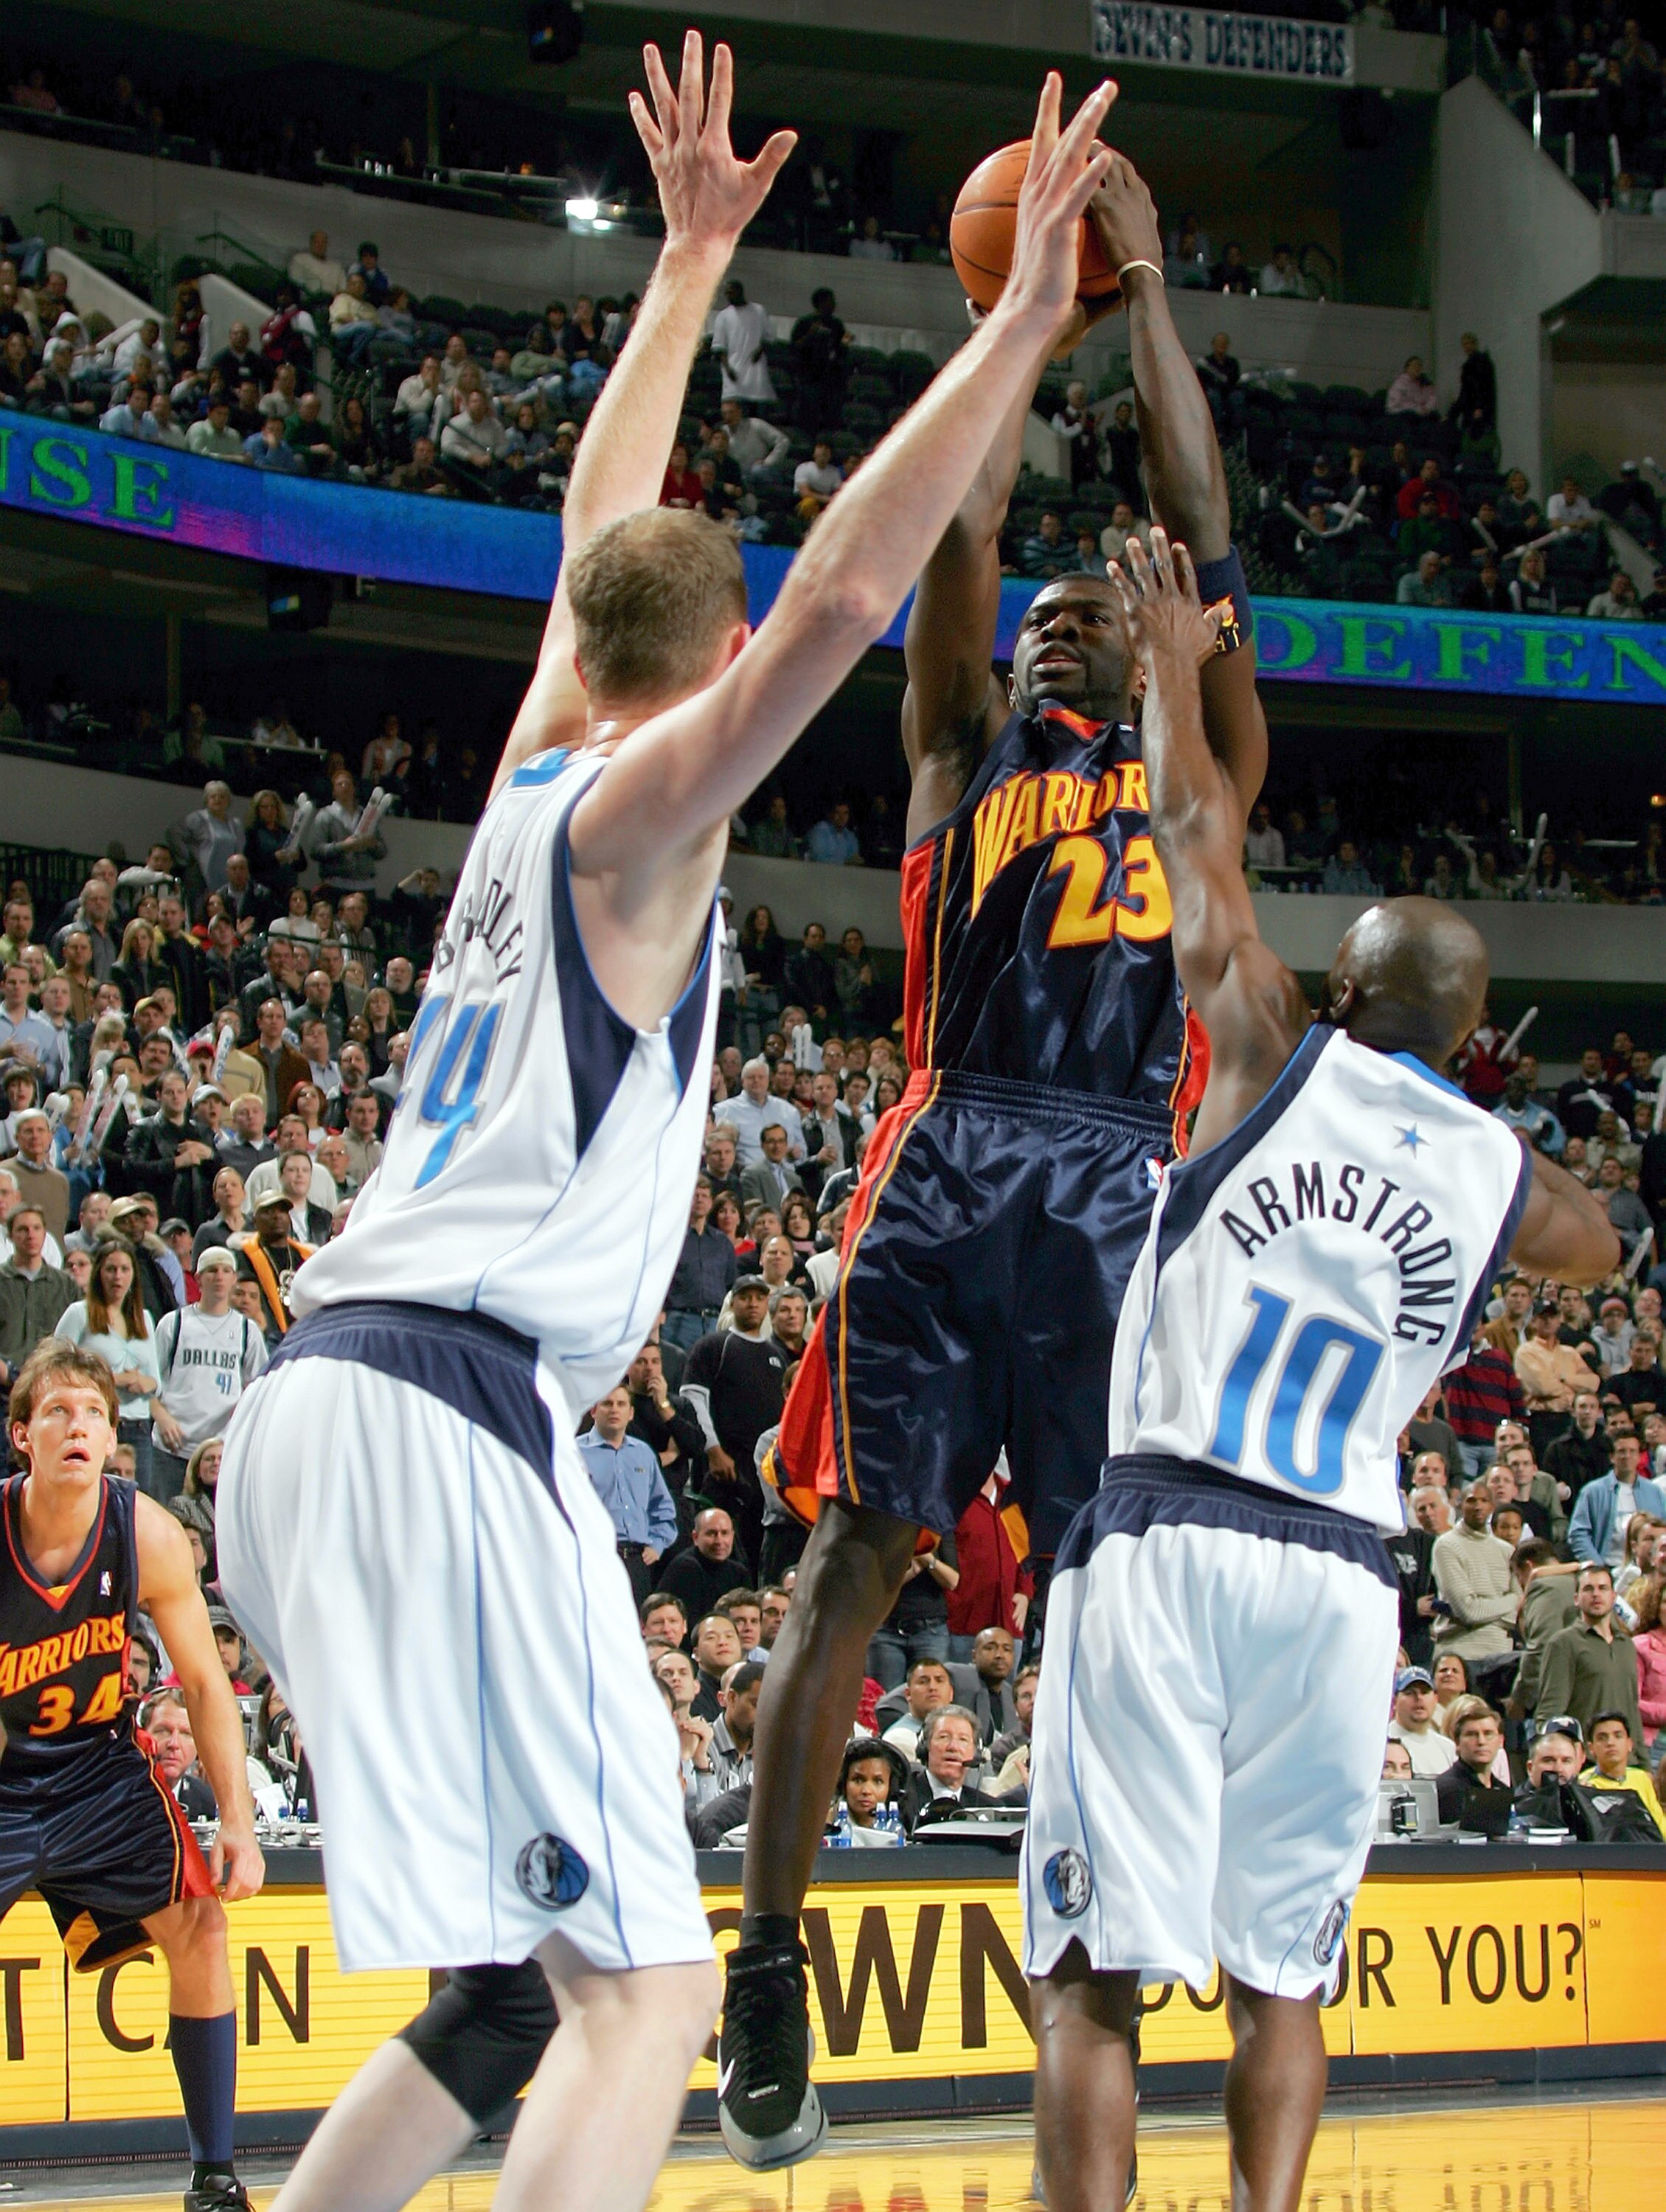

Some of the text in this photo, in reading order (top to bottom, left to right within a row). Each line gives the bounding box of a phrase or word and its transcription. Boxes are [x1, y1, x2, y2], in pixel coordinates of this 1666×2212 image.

[1205, 13, 1347, 77] DEFENDERS
[0, 426, 176, 529] SE
[1046, 833, 1174, 950] 23
[1219, 1161, 1457, 1346] ARMSTRONG
[183, 1349, 237, 1369] DALLAS
[215, 1372, 232, 1396] 41
[1204, 1278, 1389, 1501] 10
[0, 1611, 126, 1697] ARRIORS
[28, 1671, 125, 1738] 34
[97, 1946, 310, 2053] CN
[1426, 1923, 1583, 2006] YOU?
